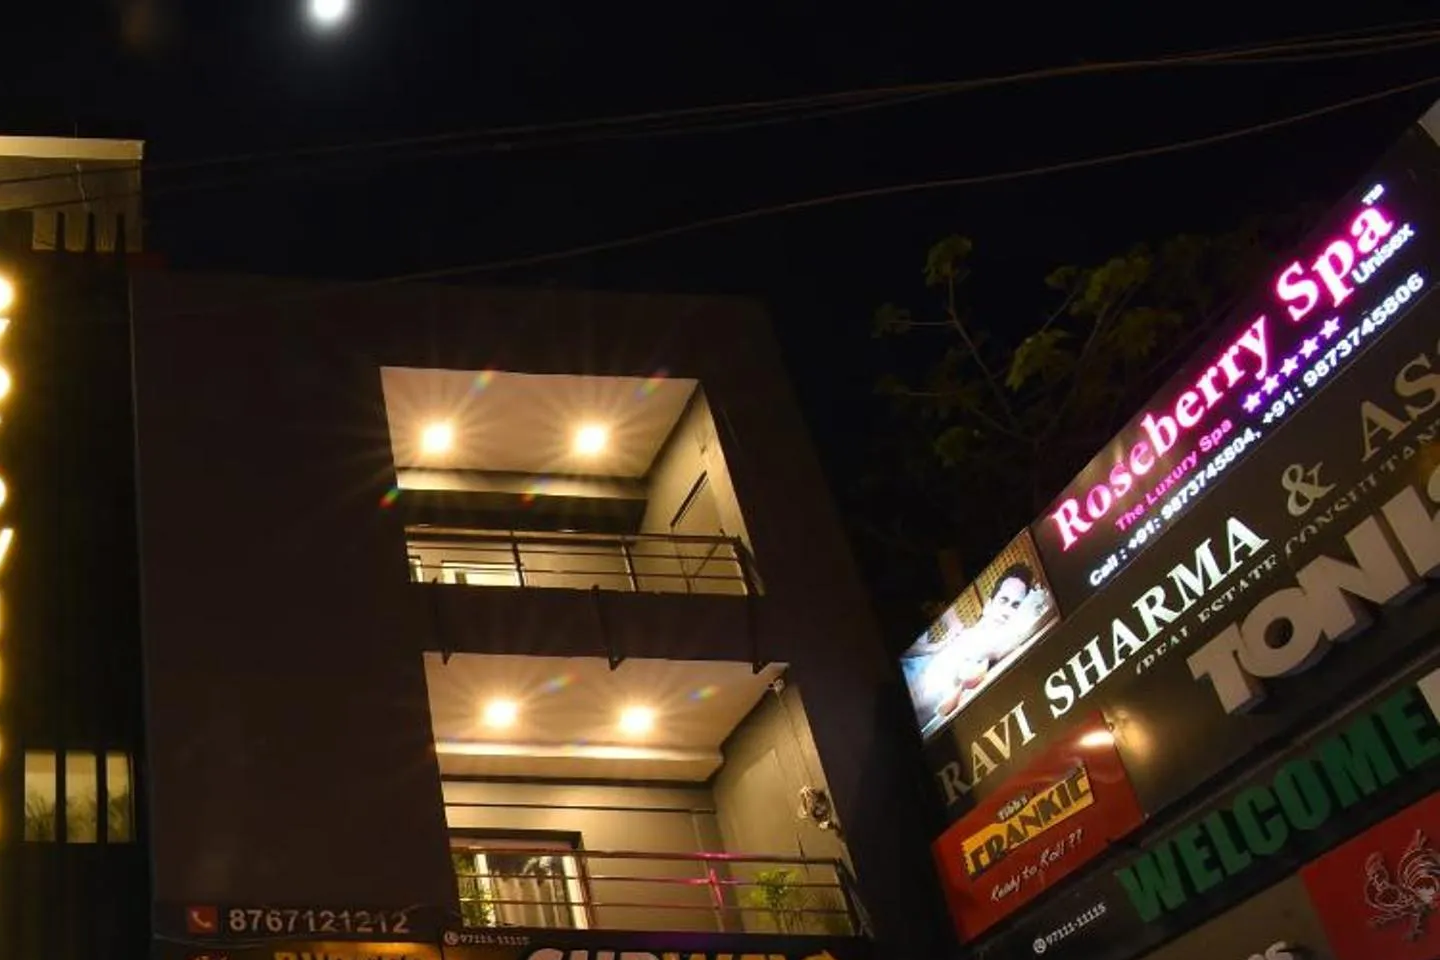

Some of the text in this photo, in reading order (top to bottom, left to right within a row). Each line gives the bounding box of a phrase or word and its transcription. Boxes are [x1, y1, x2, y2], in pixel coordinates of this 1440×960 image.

[1351, 222, 1415, 284] Unisex
[1052, 207, 1393, 551] Roseberry Spa
[1089, 554, 1119, 587] Call
[1303, 272, 1424, 388] 9873745806
[1115, 418, 1233, 532] The Luxury Spa
[936, 701, 1037, 806] RAVI
[1044, 516, 1269, 719] SHARMA
[1281, 460, 1337, 517] &
[229, 908, 409, 933] 8767121212
[1114, 685, 1440, 924] WELCOME
